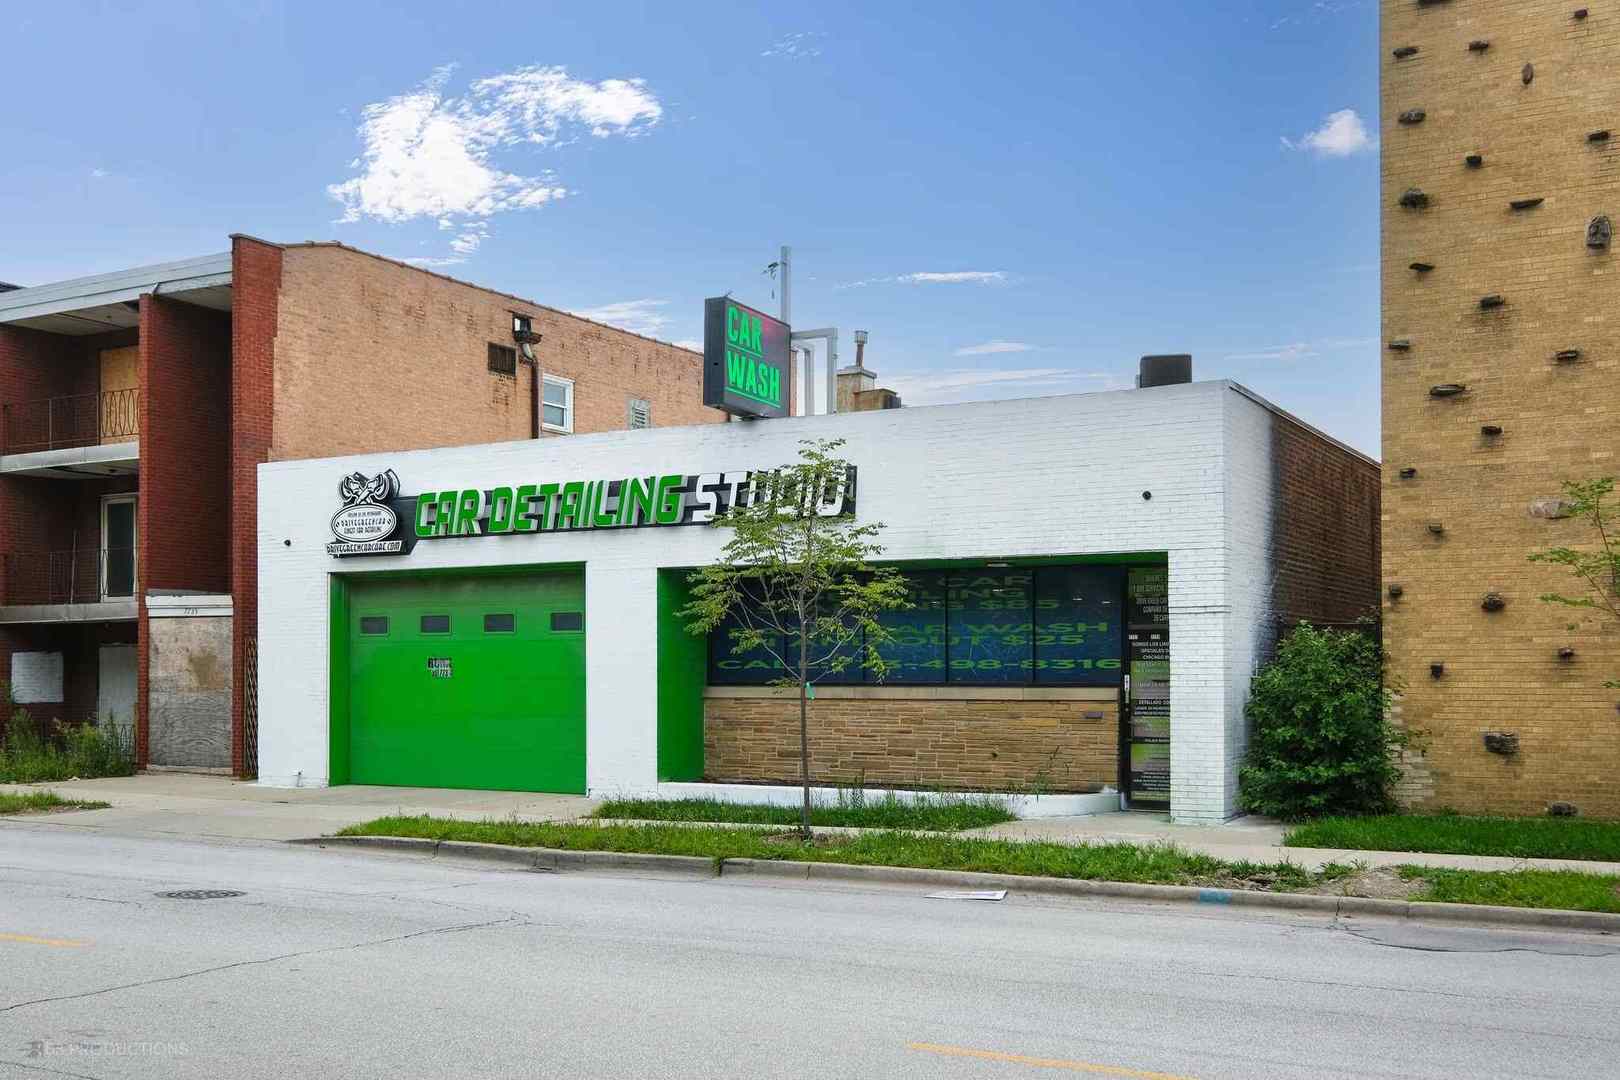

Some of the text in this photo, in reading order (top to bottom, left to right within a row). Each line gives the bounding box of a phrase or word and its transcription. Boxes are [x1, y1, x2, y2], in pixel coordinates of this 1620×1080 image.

[727, 304, 763, 355] CAR
[727, 350, 781, 401] WASH
[415, 489, 482, 537] CAR
[489, 474, 684, 532] DETAILING
[937, 576, 1033, 588] CAR
[896, 635, 982, 646] OUT
[1001, 634, 1086, 646] $25
[966, 622, 1109, 634] WASH
